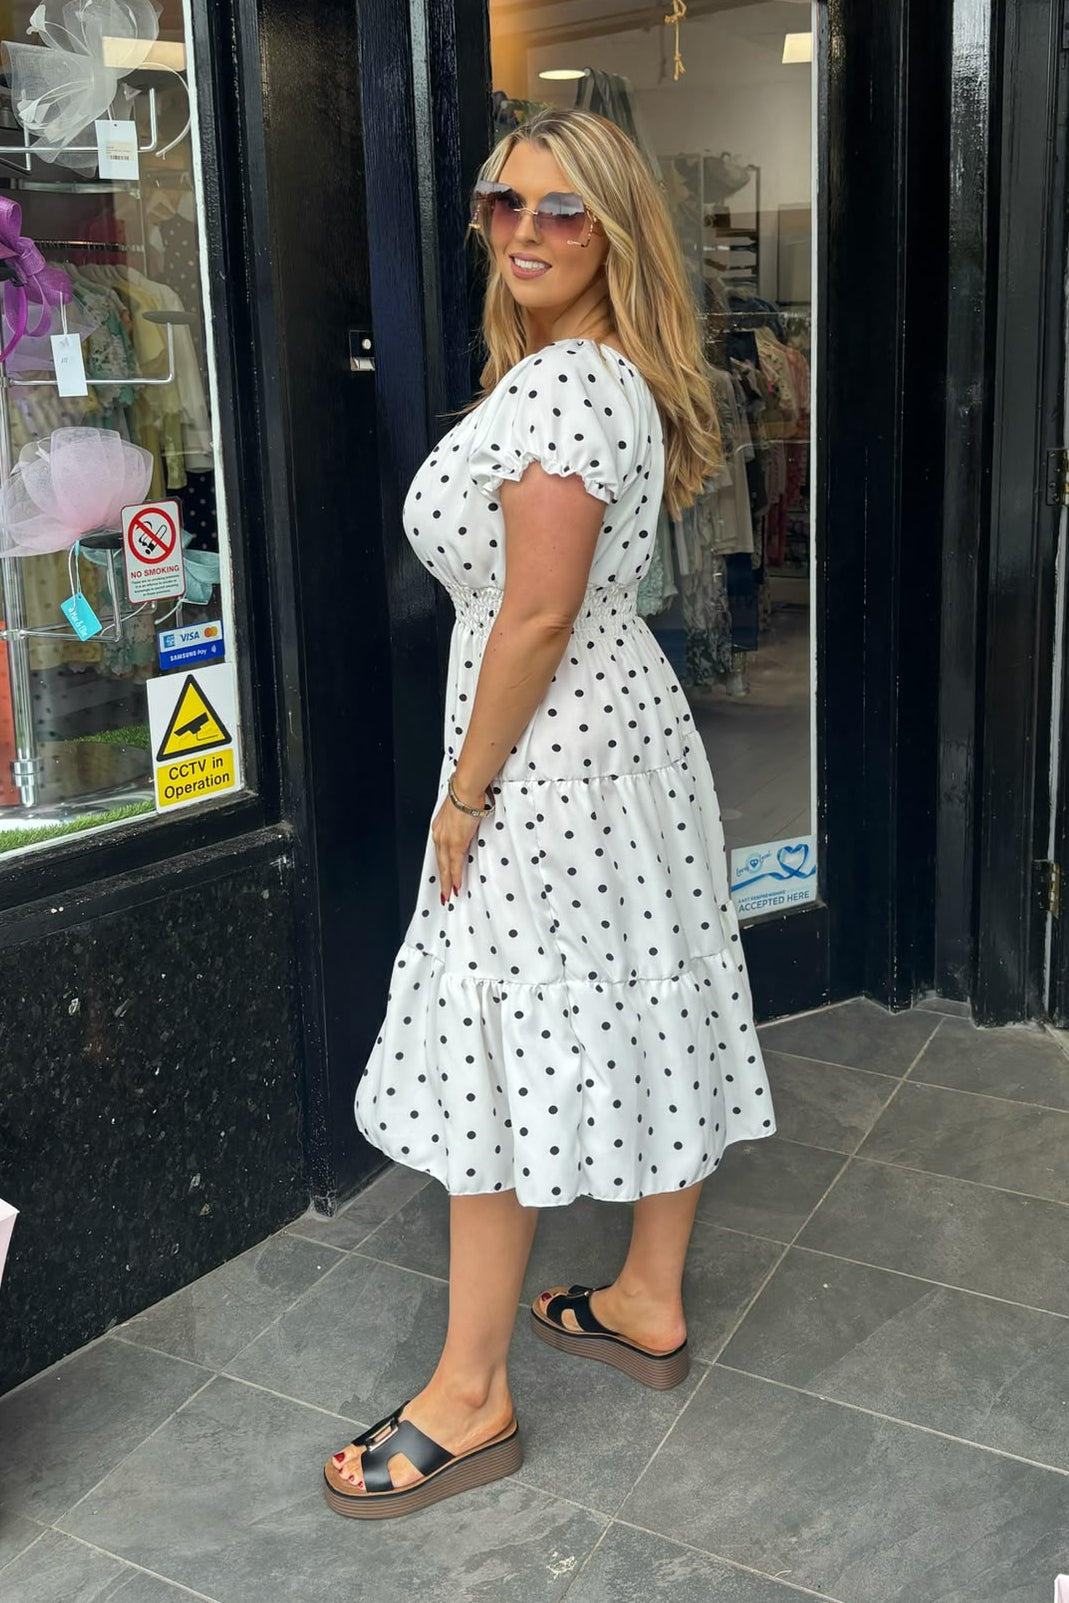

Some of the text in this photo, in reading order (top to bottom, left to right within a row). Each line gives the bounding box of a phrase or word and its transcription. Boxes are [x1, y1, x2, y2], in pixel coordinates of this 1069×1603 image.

[130, 570, 142, 579] NO
[144, 564, 180, 577] SMOKING
[180, 631, 200, 642] VISA
[170, 650, 197, 662] SAMSUNG
[169, 756, 223, 780] CCTV in
[164, 772, 230, 799] Operation
[738, 890, 810, 912] ACCEPTED HERE
